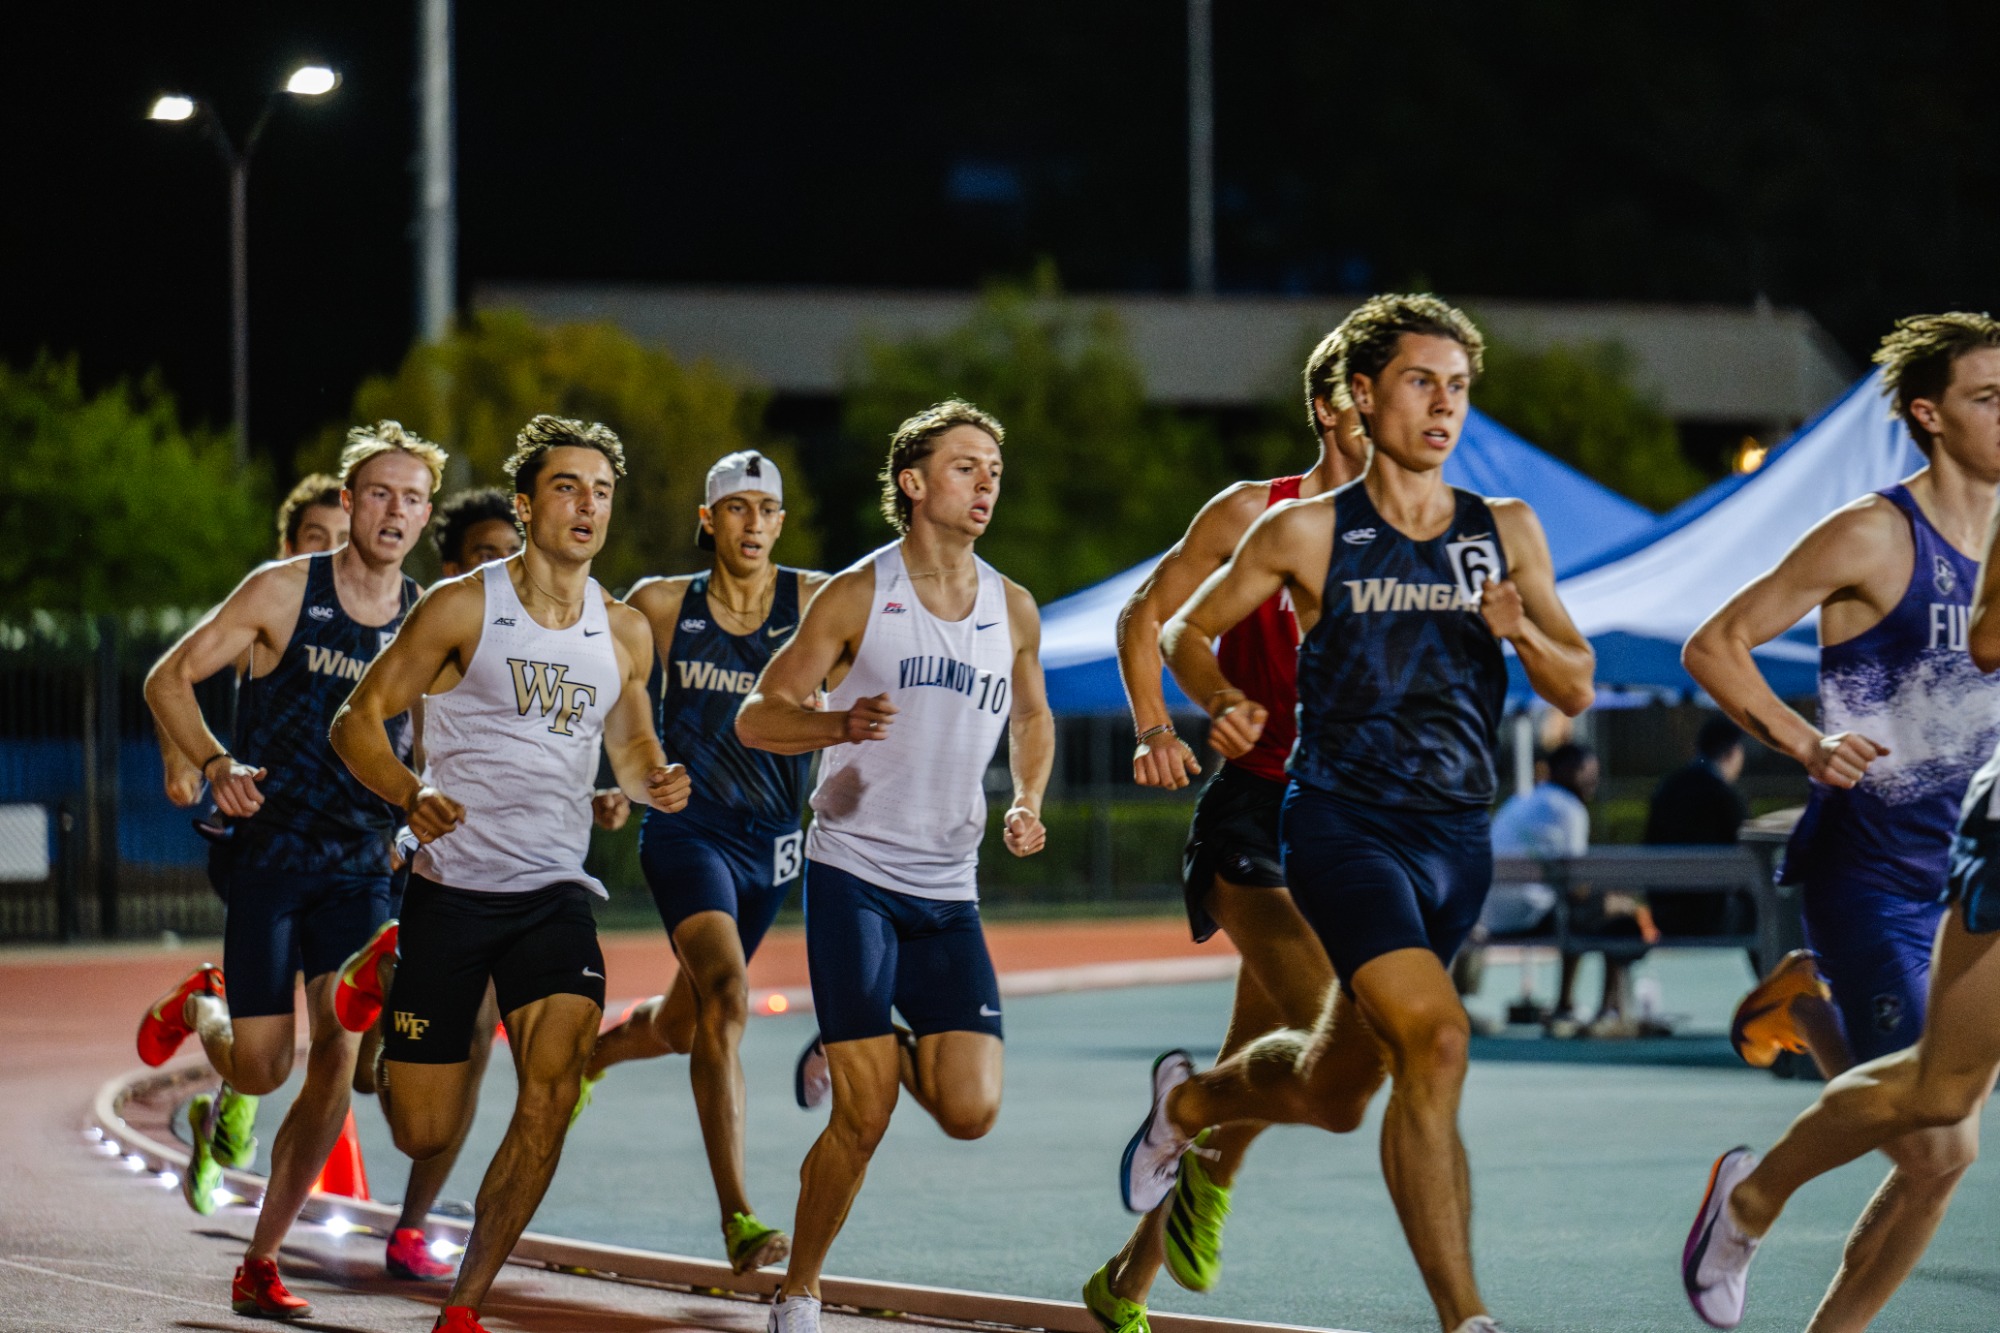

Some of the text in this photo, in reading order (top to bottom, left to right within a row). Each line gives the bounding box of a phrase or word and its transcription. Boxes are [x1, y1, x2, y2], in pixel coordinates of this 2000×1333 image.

[1460, 546, 1490, 596] 6
[308, 605, 334, 621] SAC
[1342, 577, 1479, 613] WINGA
[493, 617, 516, 627] ACC
[681, 619, 706, 633] SAC
[1928, 603, 1973, 651] FU
[304, 644, 371, 681] WIN
[675, 660, 756, 694] WING
[899, 655, 977, 697] VILLANOV
[506, 657, 597, 737] WF
[978, 673, 1007, 714] 10
[780, 838, 797, 878] 3
[394, 1010, 430, 1040] WF
